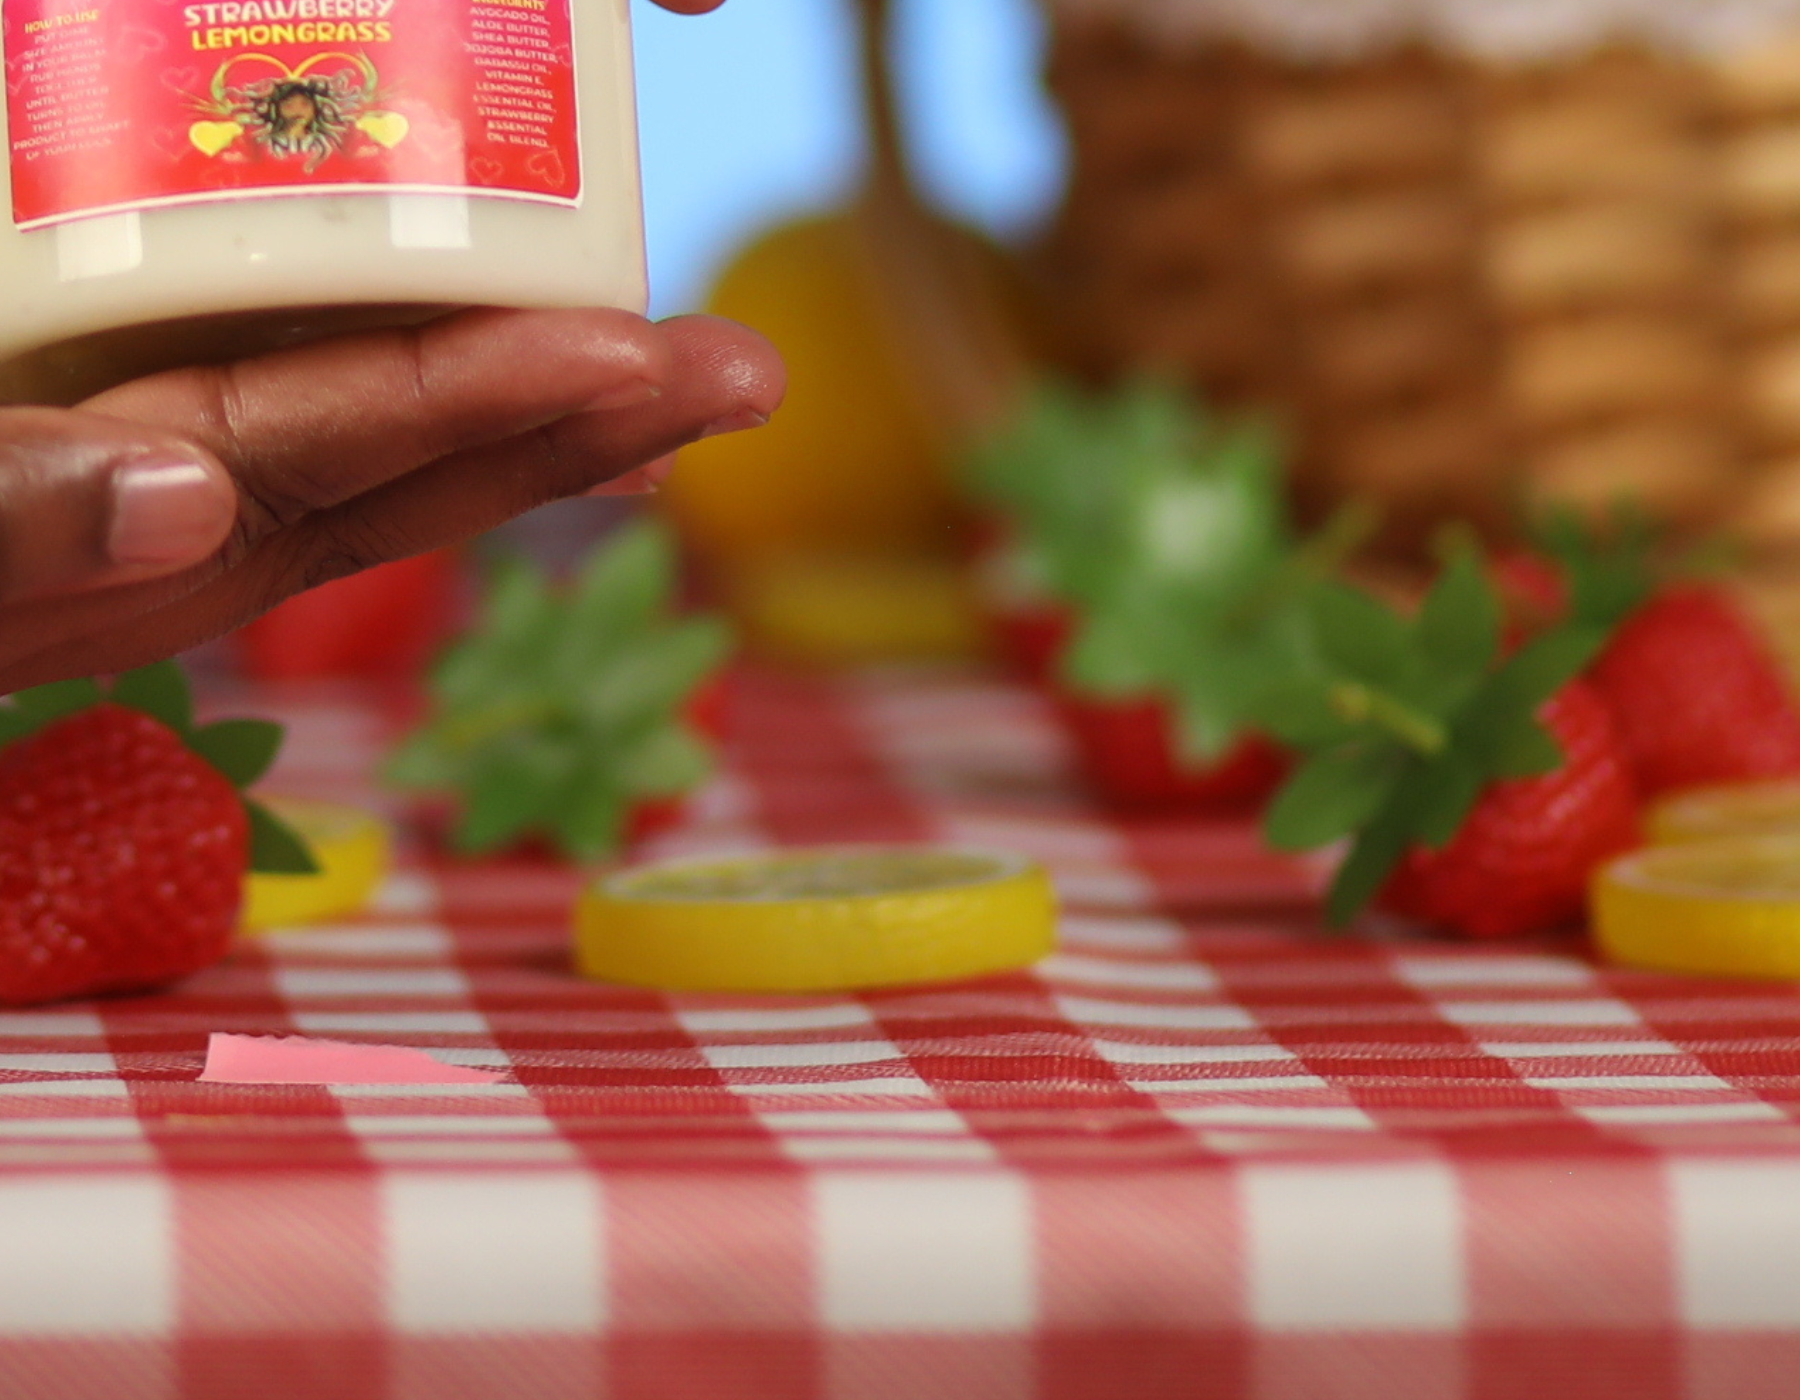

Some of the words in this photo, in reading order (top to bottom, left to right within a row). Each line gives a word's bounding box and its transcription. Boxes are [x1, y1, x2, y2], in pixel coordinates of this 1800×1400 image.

[25, 20, 52, 33] HOW
[57, 15, 72, 26] TO
[76, 10, 99, 22] USE
[470, 7, 528, 21] AVOCADO
[472, 21, 504, 31] ALOE
[192, 21, 392, 50] LEMONGRASS
[473, 32, 505, 43] SHEA
[485, 71, 533, 83] VITAMIN
[476, 82, 554, 99] LEMONGRASS
[478, 107, 555, 124] STRAWBERRY
